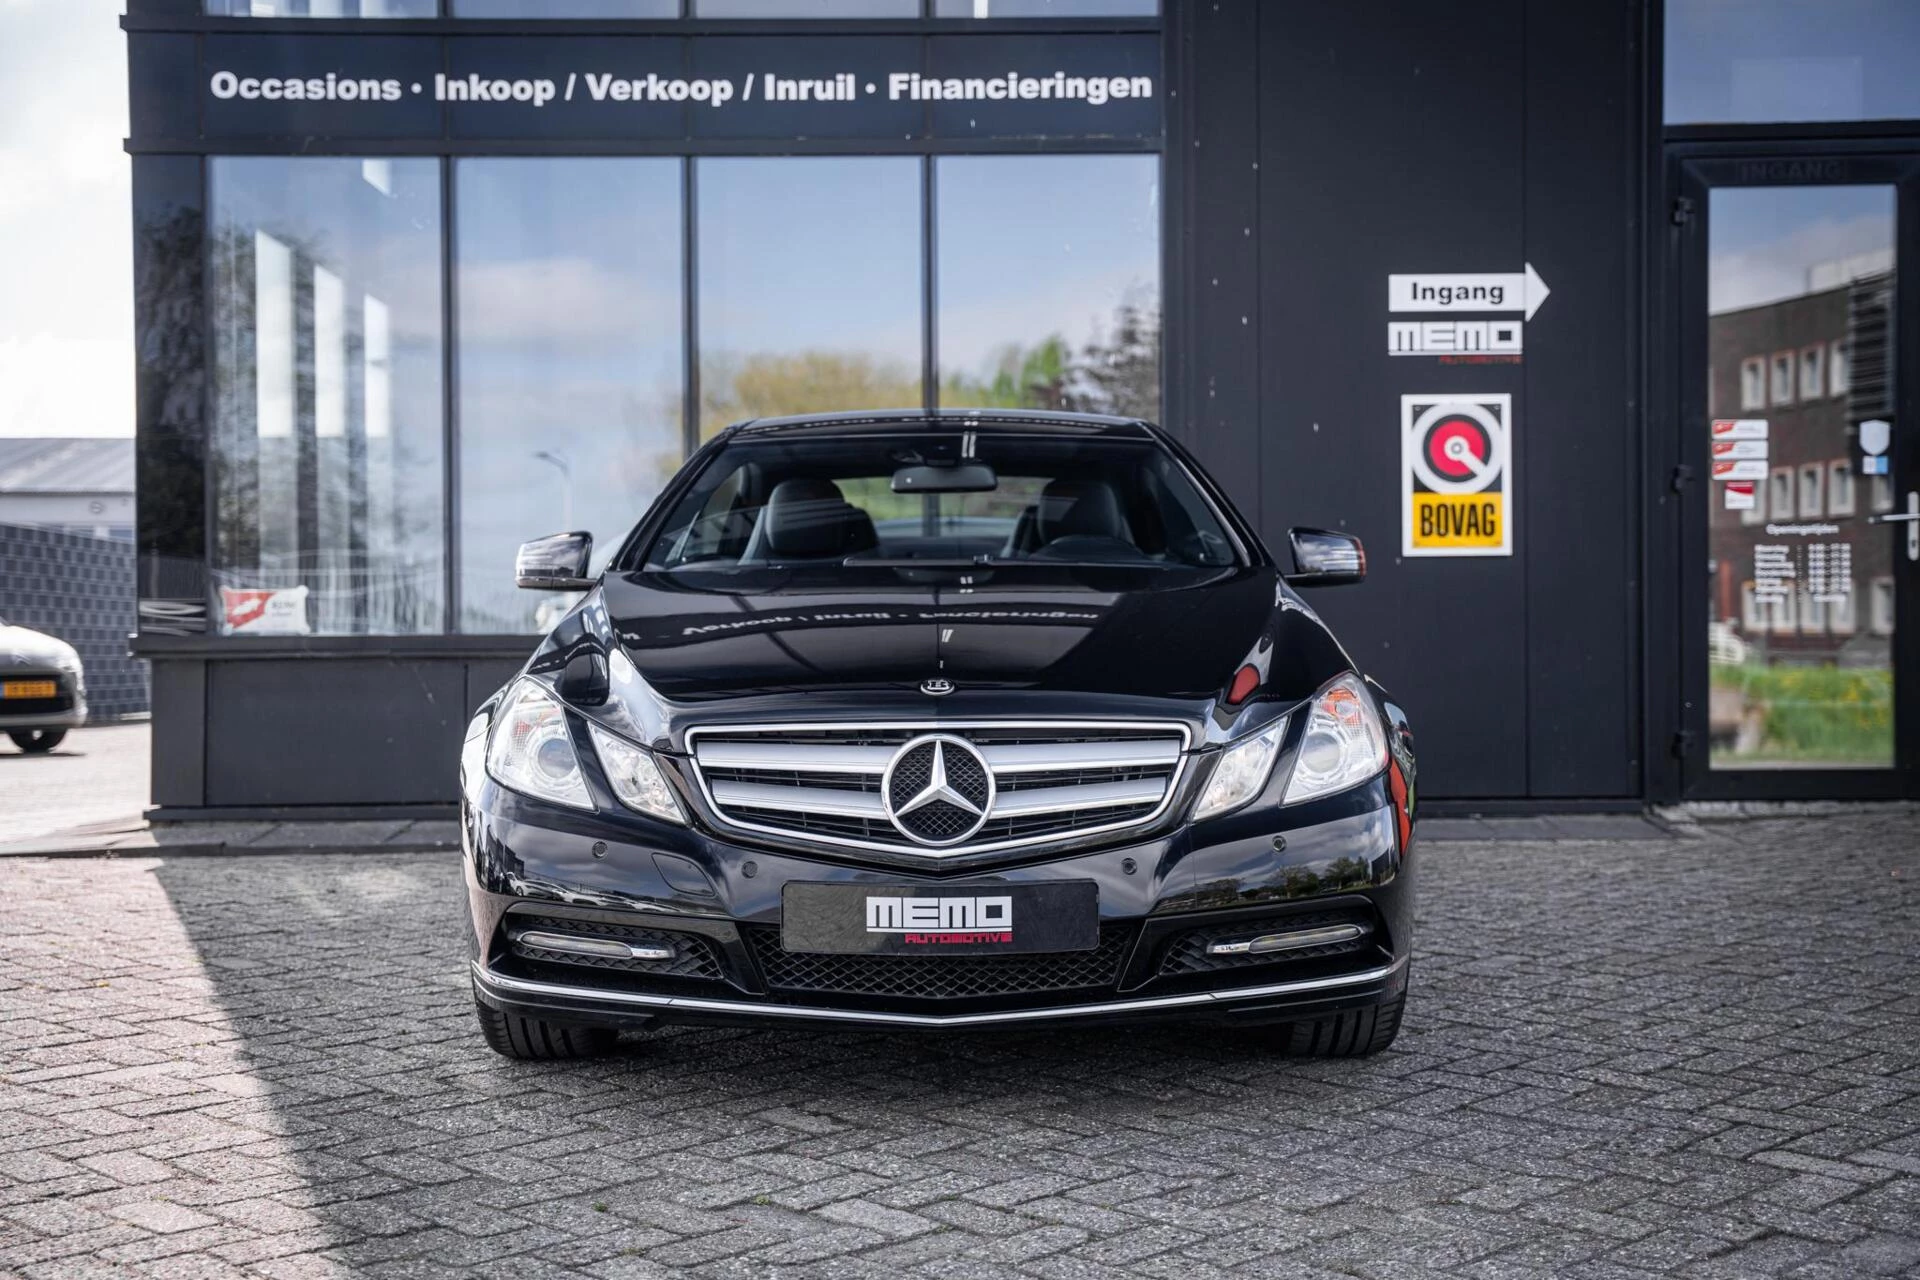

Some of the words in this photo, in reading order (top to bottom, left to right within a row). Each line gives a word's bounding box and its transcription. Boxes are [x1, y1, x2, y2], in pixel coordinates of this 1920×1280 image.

[210, 71, 401, 101] Occasions
[434, 73, 556, 107] Inkoop
[584, 73, 734, 108] Verkoop
[764, 73, 856, 101] Inruil
[888, 71, 1153, 106] Financieringen
[1411, 282, 1504, 305] Ingang
[1388, 321, 1523, 352] MEMO
[1420, 503, 1496, 537] BOVAG
[866, 896, 1012, 928] MEMO
[905, 932, 1013, 944] AUTOMOTIVE
